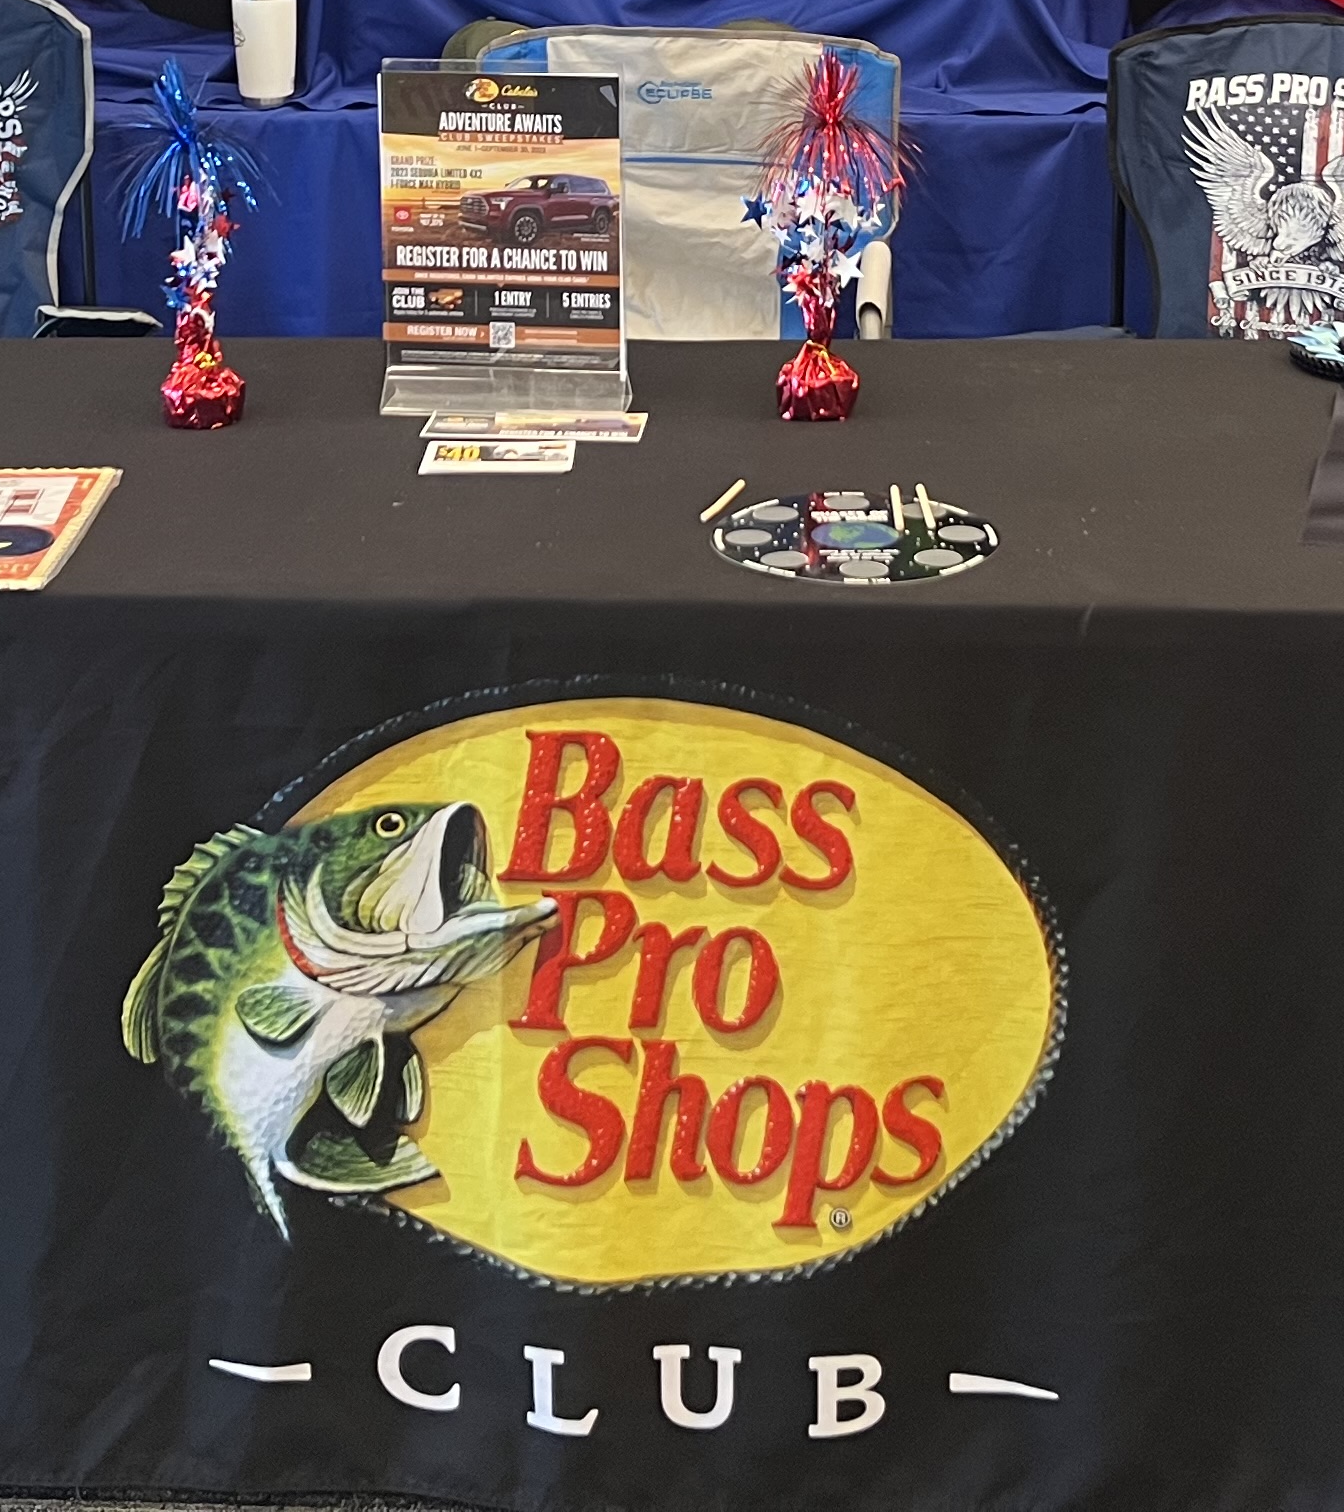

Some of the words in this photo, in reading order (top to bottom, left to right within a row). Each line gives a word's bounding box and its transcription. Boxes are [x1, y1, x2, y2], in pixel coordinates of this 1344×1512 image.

[1185, 73, 1267, 112] BASS
[1269, 73, 1330, 105] PRO
[439, 111, 511, 133] ADVENTURE
[513, 113, 562, 134] AWAITS
[440, 132, 471, 142] CLUB
[477, 133, 562, 144] SWEEPSTAKES
[396, 245, 459, 267] REGISTER
[462, 247, 488, 268] FOR
[490, 248, 501, 269] A
[503, 248, 557, 270] CHANCE
[559, 250, 578, 271] TO
[579, 250, 608, 272] WIN
[1233, 270, 1296, 287] SINCE
[392, 296, 425, 308] CLUB
[494, 291, 500, 305] 1
[500, 291, 532, 307] ENTRY
[562, 292, 570, 307] 5
[571, 293, 611, 308] ENTRIES
[407, 325, 453, 337] REGISTER
[454, 326, 478, 337] NOW
[498, 728, 856, 890] Bass
[508, 888, 779, 1034] Pro
[513, 1037, 946, 1231] Shops
[375, 1324, 888, 1438] CLUB
